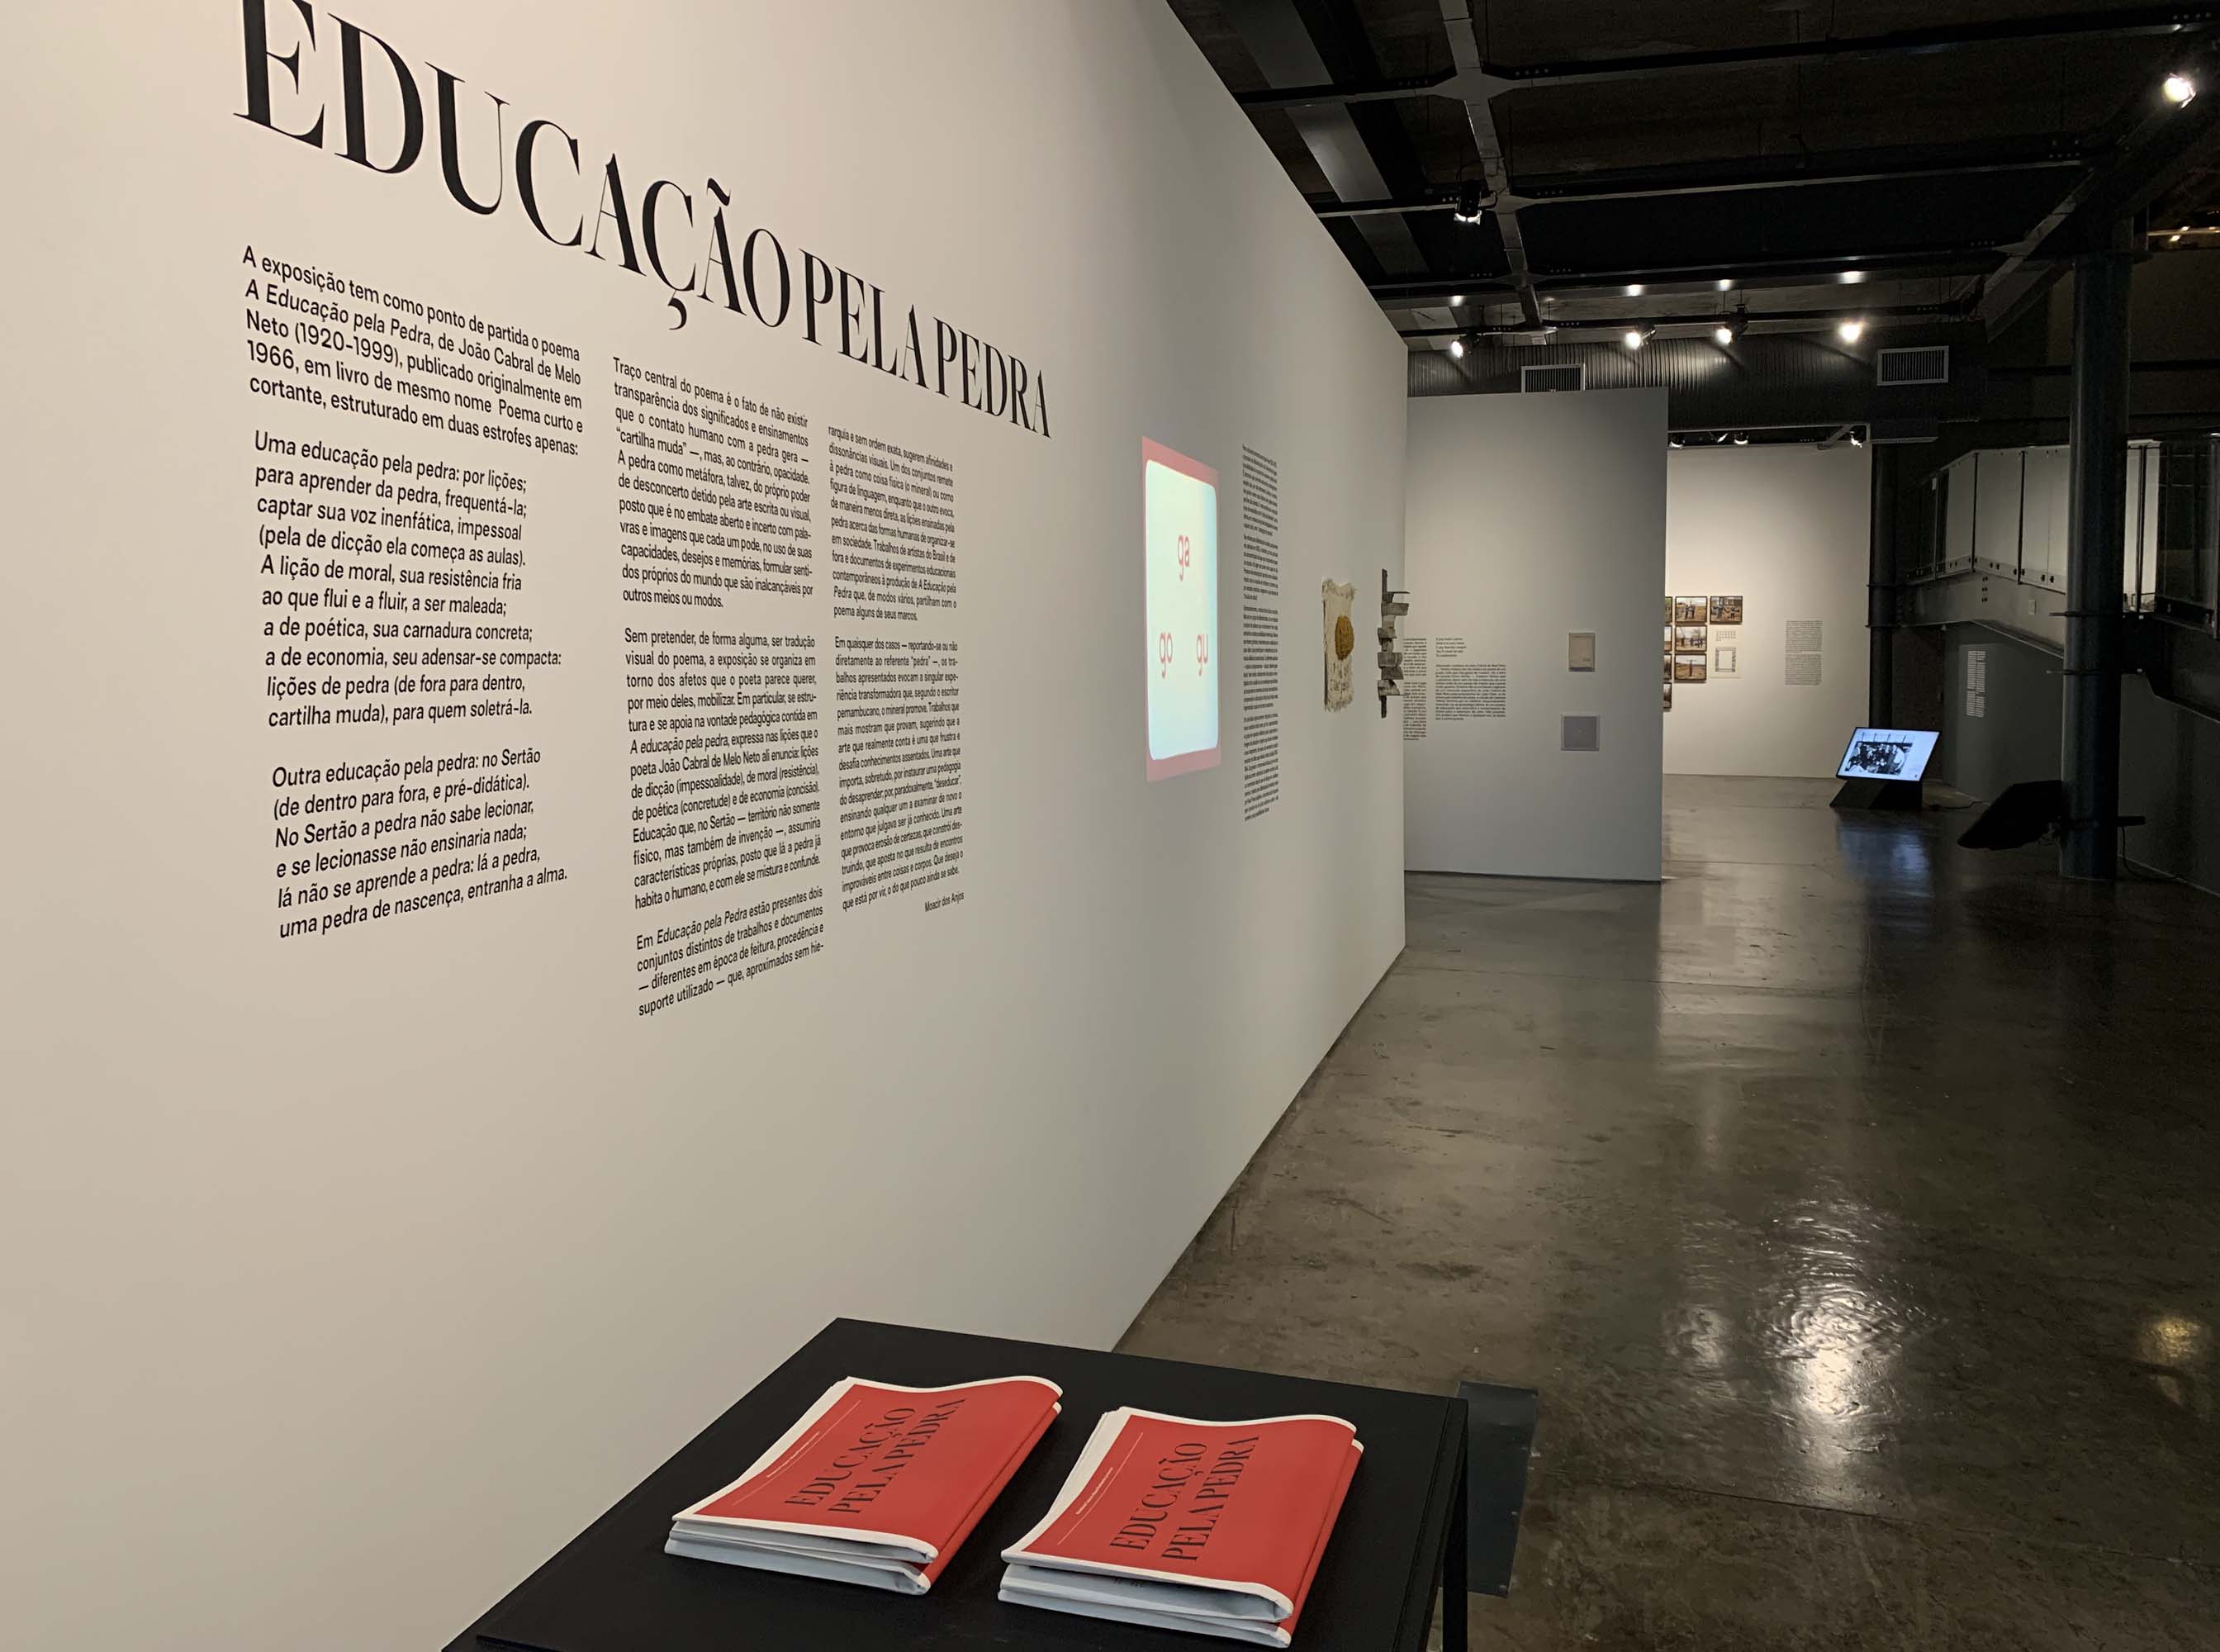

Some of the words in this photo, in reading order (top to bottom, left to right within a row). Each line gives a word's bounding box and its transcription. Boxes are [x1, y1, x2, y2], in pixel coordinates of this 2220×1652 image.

[234, 0, 790, 331] EDUCAÇÃO
[799, 249, 928, 389] PELA
[933, 316, 1051, 439] PEDRA
[242, 244, 257, 268] A
[261, 257, 346, 295] exposição
[348, 279, 380, 305] tem
[382, 292, 425, 317] como
[426, 306, 467, 330] ponto
[468, 314, 485, 335] de
[486, 323, 529, 348] partida
[531, 336, 539, 350] o
[540, 339, 581, 362] poema
[244, 278, 260, 301] A
[265, 282, 349, 325] Educação
[353, 312, 386, 335] pela
[390, 317, 434, 350] Pedra,
[437, 331, 455, 353] de
[458, 337, 491, 362] João
[493, 346, 534, 373] Cabral
[537, 358, 552, 378] de
[554, 363, 581, 386] Melo
[246, 307, 290, 339] Neto
[294, 321, 404, 369] (1920-1999),
[406, 354, 474, 383] publicado
[477, 370, 562, 405] originalmente
[563, 393, 582, 410] em
[246, 339, 300, 374] 1966,
[304, 358, 332, 379] em
[335, 359, 370, 387] livro
[373, 370, 393, 392] de
[396, 379, 451, 405] mesmo
[453, 392, 492, 414] nome
[498, 397, 541, 425] Poema
[543, 413, 574, 431] curto
[576, 420, 584, 434] e
[612, 356, 643, 382] Traço
[644, 370, 678, 391] central
[679, 377, 692, 394] do
[694, 385, 724, 404] poema
[725, 391, 733, 406] é
[733, 396, 740, 409] o
[741, 396, 758, 414] fato
[758, 401, 770, 417] de
[771, 406, 786, 422] não
[786, 411, 809, 429] existir
[249, 377, 327, 410] cortante,
[330, 393, 419, 425] estruturado
[421, 412, 444, 430] em
[447, 413, 480, 437] duas
[482, 425, 533, 448] estrofes
[534, 435, 579, 456] apenas:
[614, 381, 681, 412] transparência
[681, 399, 699, 418] dos
[700, 405, 750, 431] significados
[751, 422, 757, 434] e
[757, 424, 809, 448] ensinamentos
[254, 429, 296, 457] Uma
[301, 439, 379, 471] educação
[382, 453, 413, 476] pela
[415, 460, 460, 482] pedra:
[462, 469, 486, 488] por
[487, 468, 527, 494] lições;
[254, 466, 295, 487] para
[298, 472, 372, 496] aprender
[375, 478, 394, 499] da
[396, 485, 442, 509] pedra,
[444, 487, 528, 520] frequentá-la;
[617, 449, 627, 466] A
[628, 453, 657, 472] pedra
[657, 461, 685, 477] como
[685, 467, 726, 487] metáfora,
[726, 473, 752, 493] talvez,
[752, 478, 764, 494] do
[764, 482, 790, 501] próprio
[790, 488, 811, 504] poder
[256, 497, 314, 521] captar
[316, 504, 346, 522] sua
[349, 508, 377, 525] voz
[380, 506, 454, 536] inenfática,
[457, 515, 523, 542] impessoal
[1177, 534, 1191, 582] ga
[624, 626, 648, 643] Sem
[650, 629, 697, 648] pretender,
[698, 630, 710, 646] de
[711, 630, 738, 646] forma
[738, 632, 771, 650] alguma,
[771, 636, 784, 648] ser
[784, 634, 816, 651] tradução
[624, 649, 655, 666] visual
[657, 650, 671, 666] do
[672, 654, 707, 670] poema,
[709, 655, 715, 666] a
[717, 652, 758, 670] exposição
[759, 655, 770, 667] se
[771, 653, 803, 670] organiza
[804, 656, 817, 667] em
[1159, 632, 1174, 680] go
[1196, 634, 1209, 677] gu
[272, 766, 321, 788] Outra
[325, 758, 401, 783] educação
[403, 754, 434, 781] pela
[436, 752, 480, 778] pedra:
[481, 754, 499, 768] no
[500, 747, 542, 767] Sertão
[273, 795, 301, 821] (de
[304, 793, 358, 815] dentro
[360, 790, 395, 814] para
[398, 784, 429, 804] fora,
[432, 786, 442, 800] e
[444, 772, 530, 804] pré-didática).
[279, 917, 318, 939] uma
[321, 904, 368, 936] pedra
[372, 898, 391, 919] de
[394, 888, 464, 915] nascença,
[467, 873, 524, 900] entranha
[526, 874, 534, 887] a
[536, 866, 568, 885] alma.
[636, 933, 654, 951] Em
[656, 919, 703, 945] Educação
[703, 914, 723, 936] pela
[723, 907, 748, 925] Pedra
[748, 900, 771, 918] estão
[771, 892, 808, 915] presentes
[808, 885, 823, 900] dois
[636, 947, 685, 973] conjuntos
[685, 936, 723, 957] distintos
[724, 930, 736, 945] de
[736, 920, 773, 942] trabalhos
[773, 919, 780, 930] e
[780, 905, 824, 928] documentos
[784, 1408, 916, 1506] EDUCAÇÃO
[828, 1463, 906, 1514] PELA
[883, 1398, 965, 1460] PEDRA
[1109, 1443, 1208, 1550] EDUCAÇÃO
[1160, 1503, 1224, 1562] PELA
[1195, 1436, 1259, 1501] PEDRA
